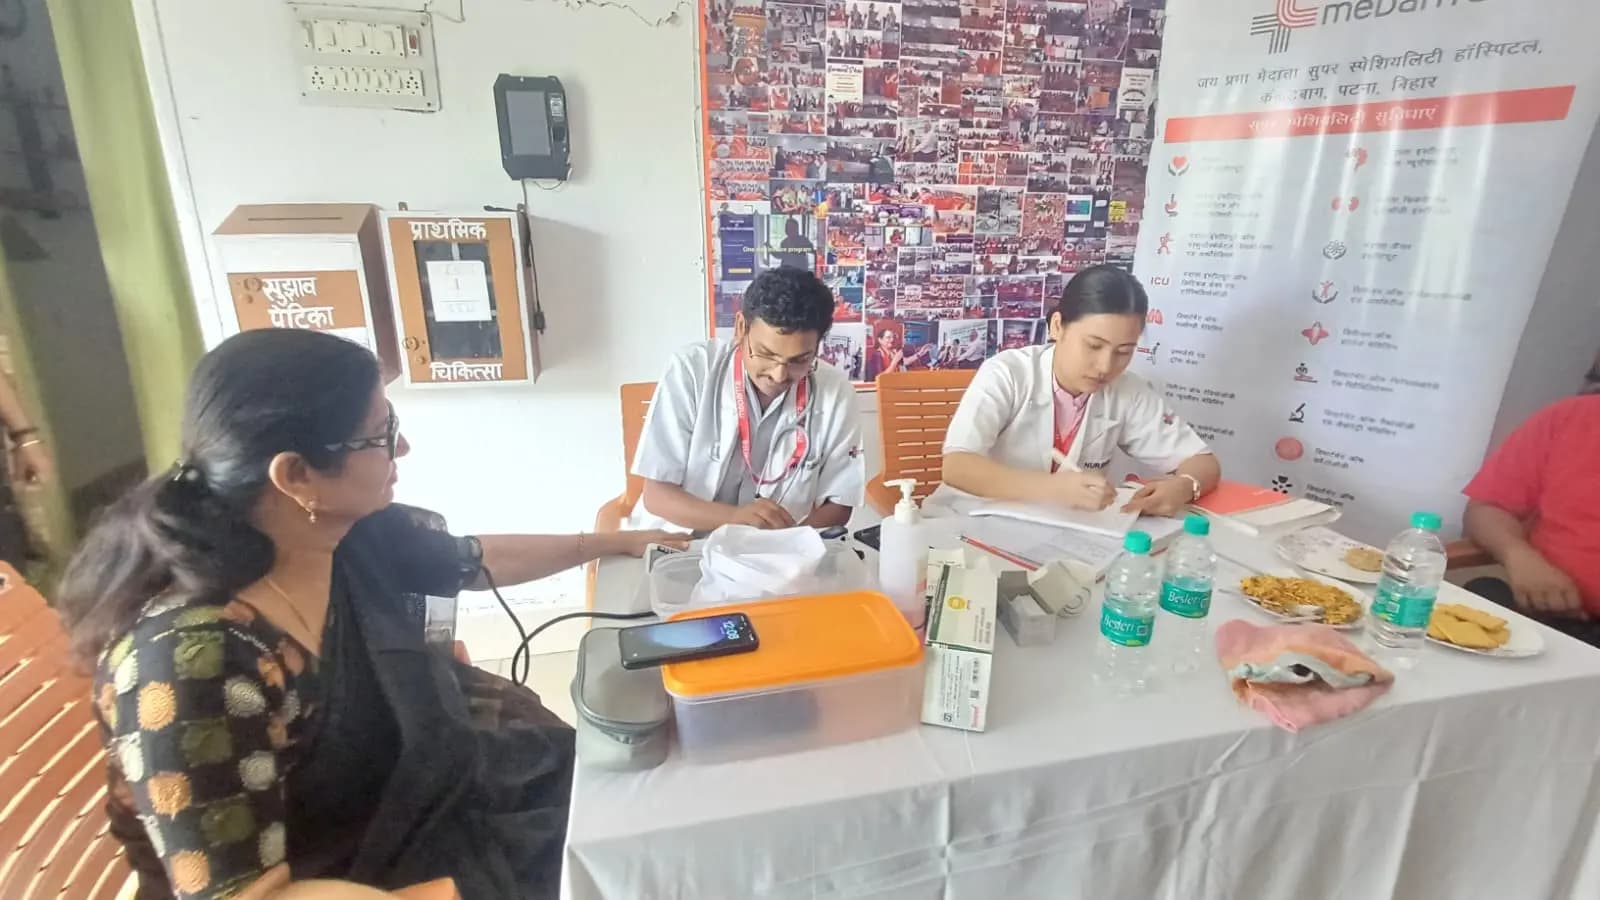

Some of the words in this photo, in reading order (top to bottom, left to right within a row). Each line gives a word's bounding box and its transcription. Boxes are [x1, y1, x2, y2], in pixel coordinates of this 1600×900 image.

[1308, 63, 1339, 81] सुपर
[1151, 276, 1170, 286] ICU
[261, 277, 318, 307] सुझाव
[266, 302, 335, 329] पेटिका
[430, 361, 503, 381] चिकित्सा
